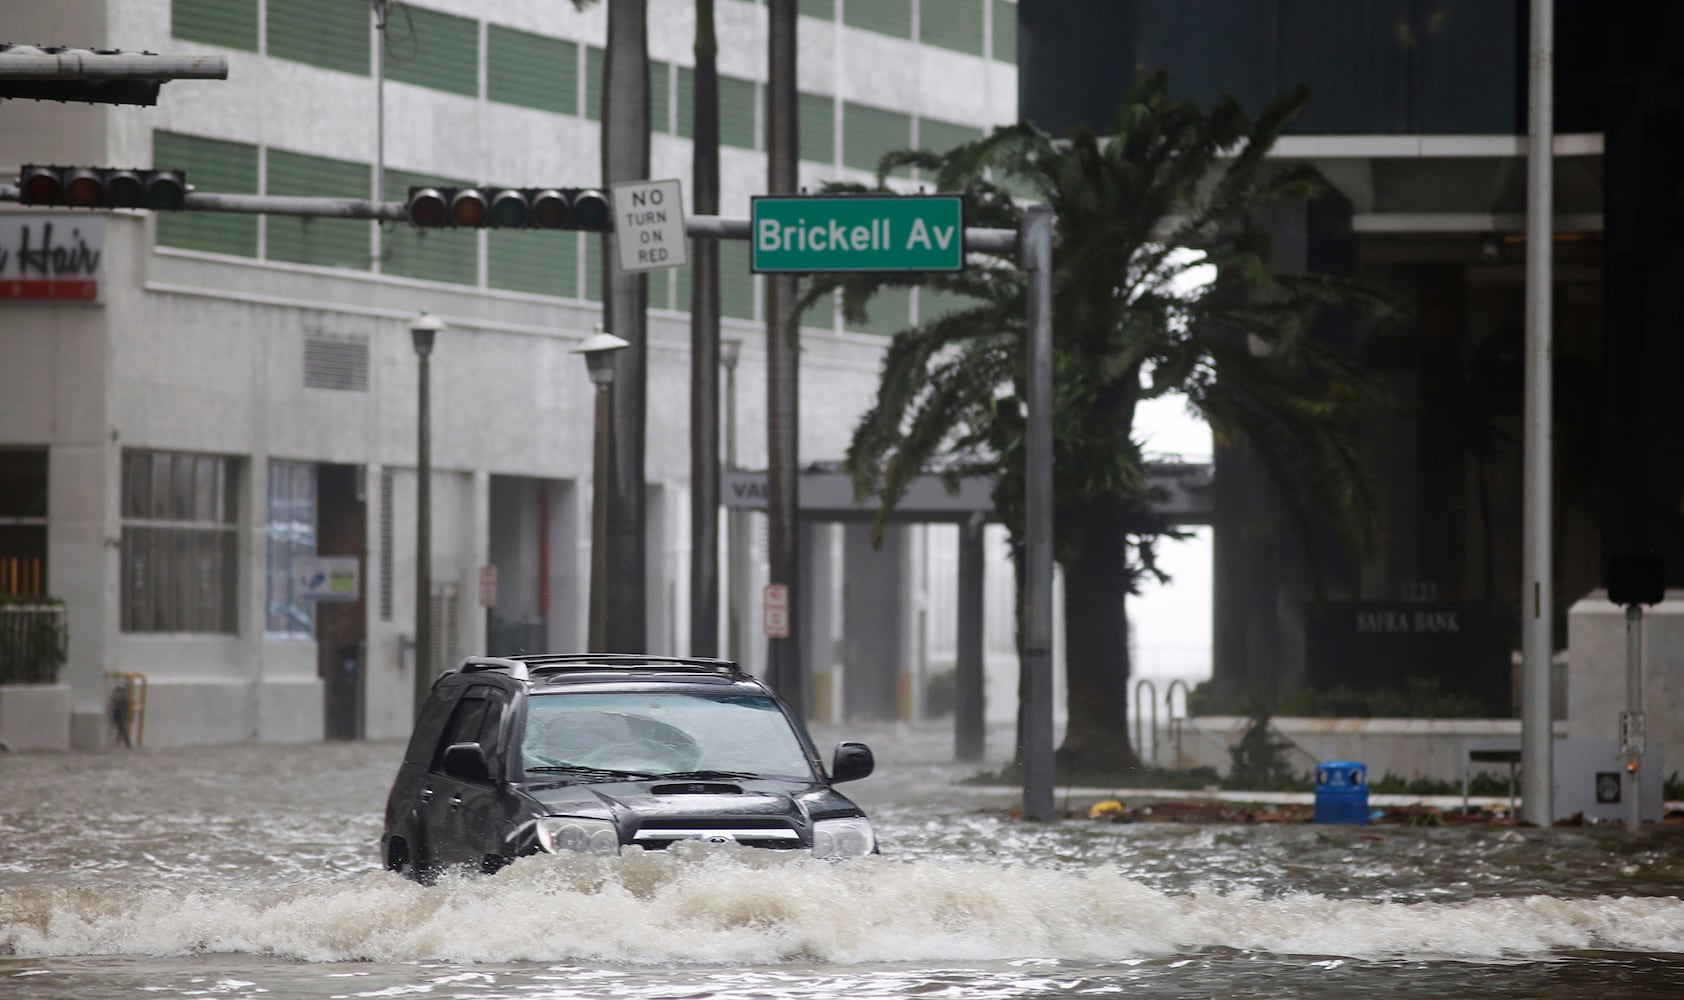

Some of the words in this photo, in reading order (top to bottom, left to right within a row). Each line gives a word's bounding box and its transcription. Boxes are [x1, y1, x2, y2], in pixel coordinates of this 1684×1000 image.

[632, 189, 664, 208] NO
[627, 211, 667, 227] TURN
[640, 230, 663, 244] ON
[759, 218, 891, 251] Brickell
[906, 217, 955, 251] Av
[17, 221, 101, 275] Hair
[638, 247, 669, 264] RED
[1414, 611, 1460, 632] BANK
